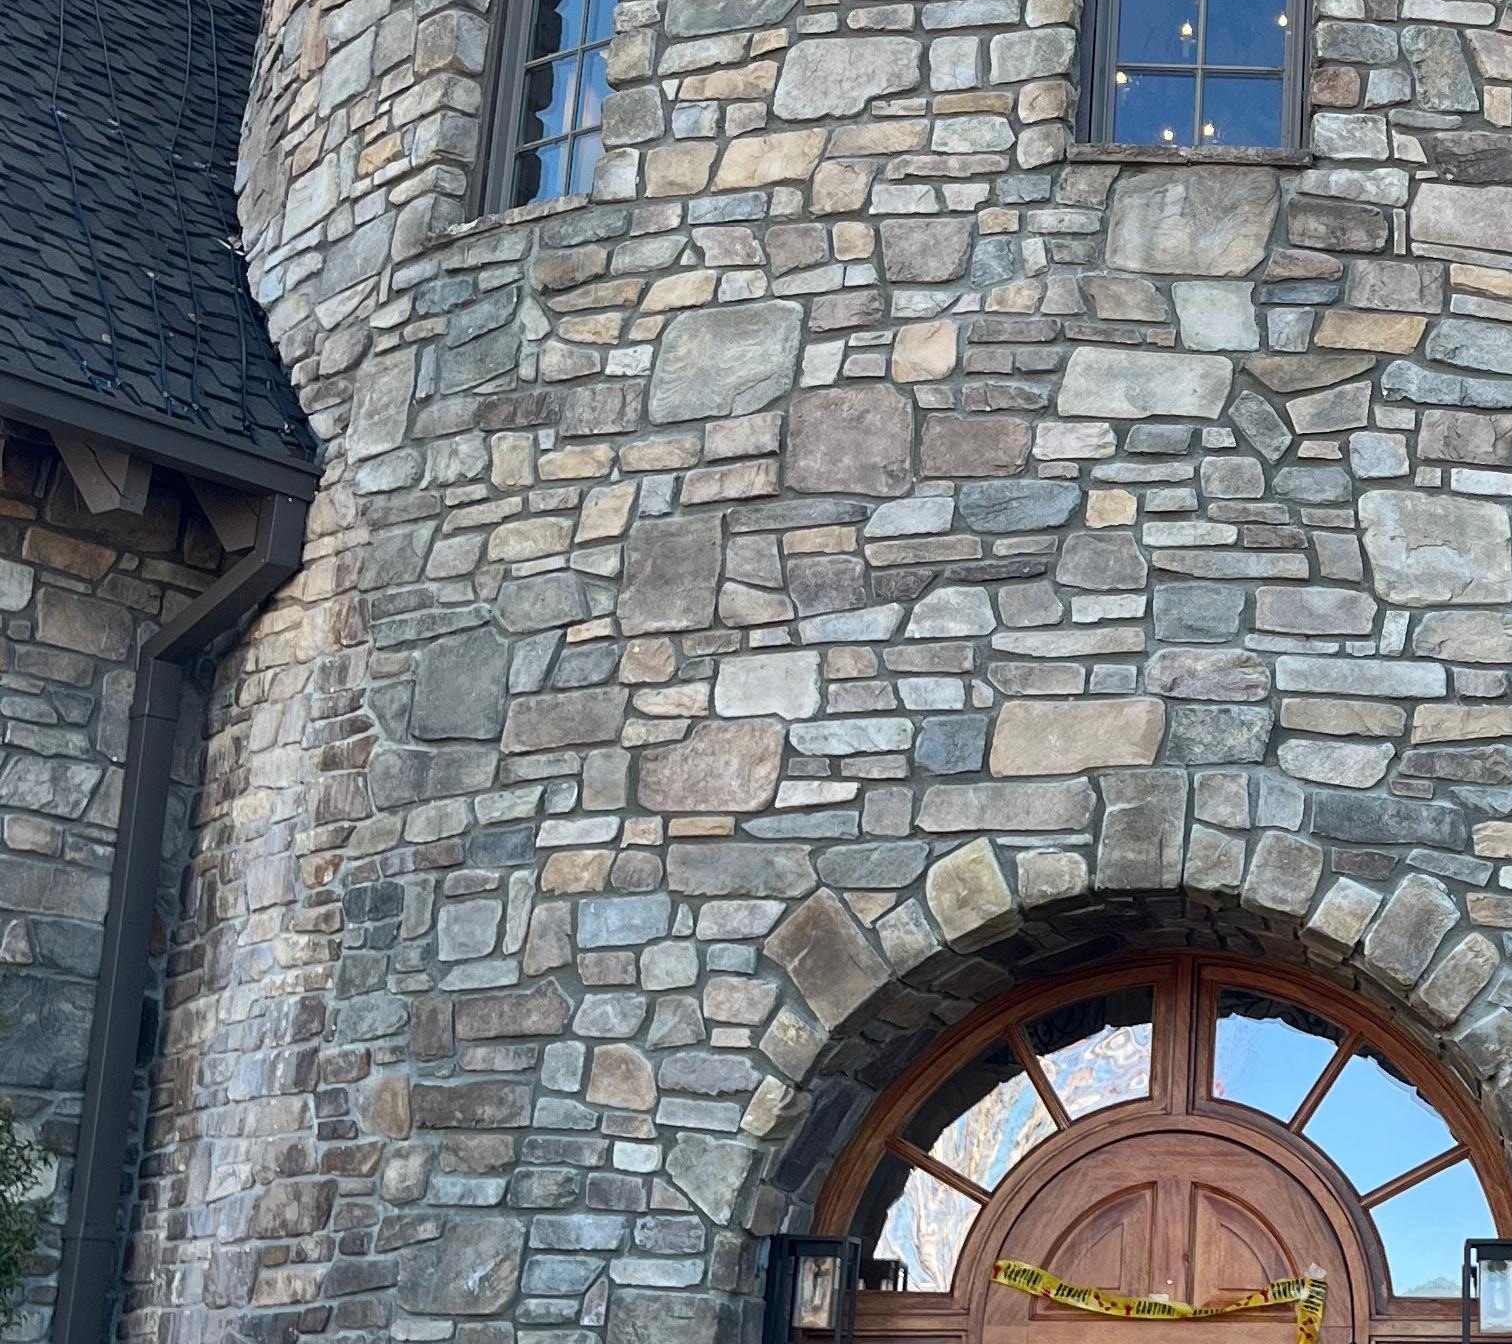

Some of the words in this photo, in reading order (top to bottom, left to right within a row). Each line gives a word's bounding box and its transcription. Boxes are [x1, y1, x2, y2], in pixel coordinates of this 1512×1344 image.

[1002, 1262, 1042, 1288] CAUTION!
[1054, 1283, 1092, 1305] BEWARE!
[1135, 1300, 1175, 1316] CAUTION!
